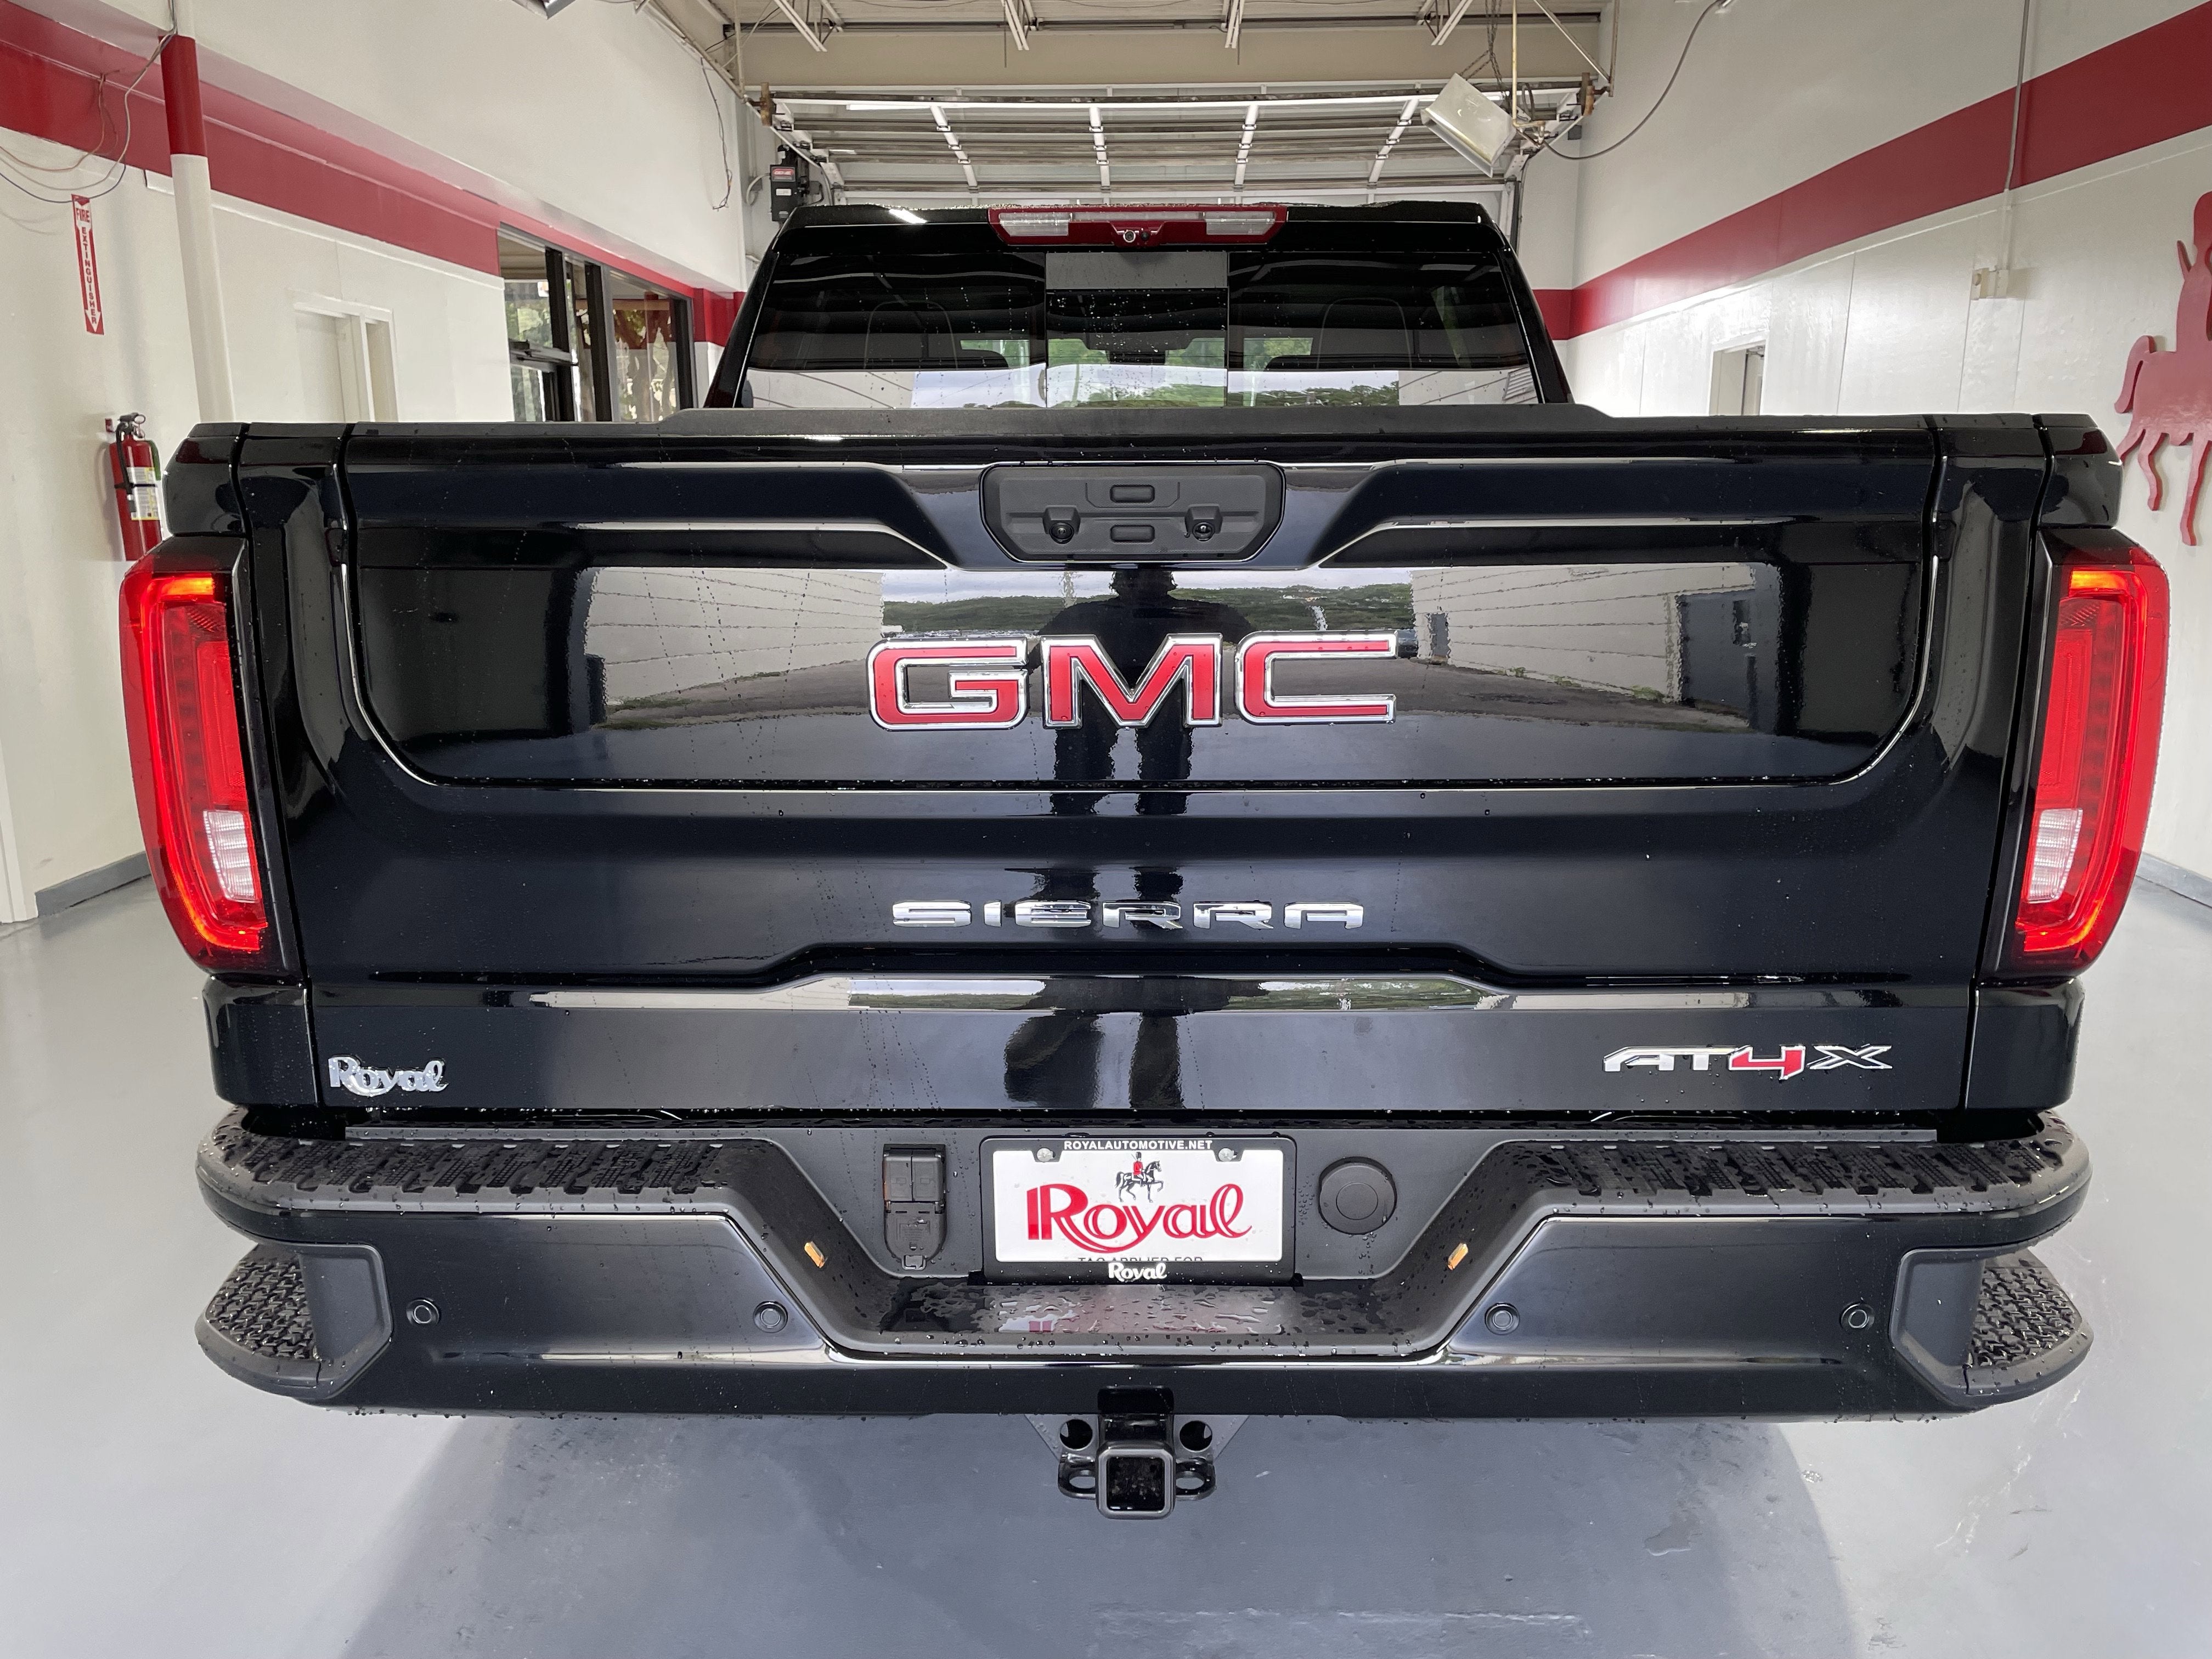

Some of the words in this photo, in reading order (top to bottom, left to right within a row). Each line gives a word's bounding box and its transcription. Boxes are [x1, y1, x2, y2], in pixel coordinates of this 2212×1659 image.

[76, 207, 90, 223] FIRE
[82, 227, 97, 324] EXTINGUISHER
[868, 630, 1399, 731] GMC
[891, 900, 1365, 929] SIERRA
[328, 1054, 449, 1097] Royal
[1603, 1043, 1893, 1080] AT4X
[1063, 1140, 1214, 1150] ROYALAUTOMOTIVE.NET
[1026, 1183, 1252, 1254] Royal
[1108, 1262, 1168, 1282] Royal
